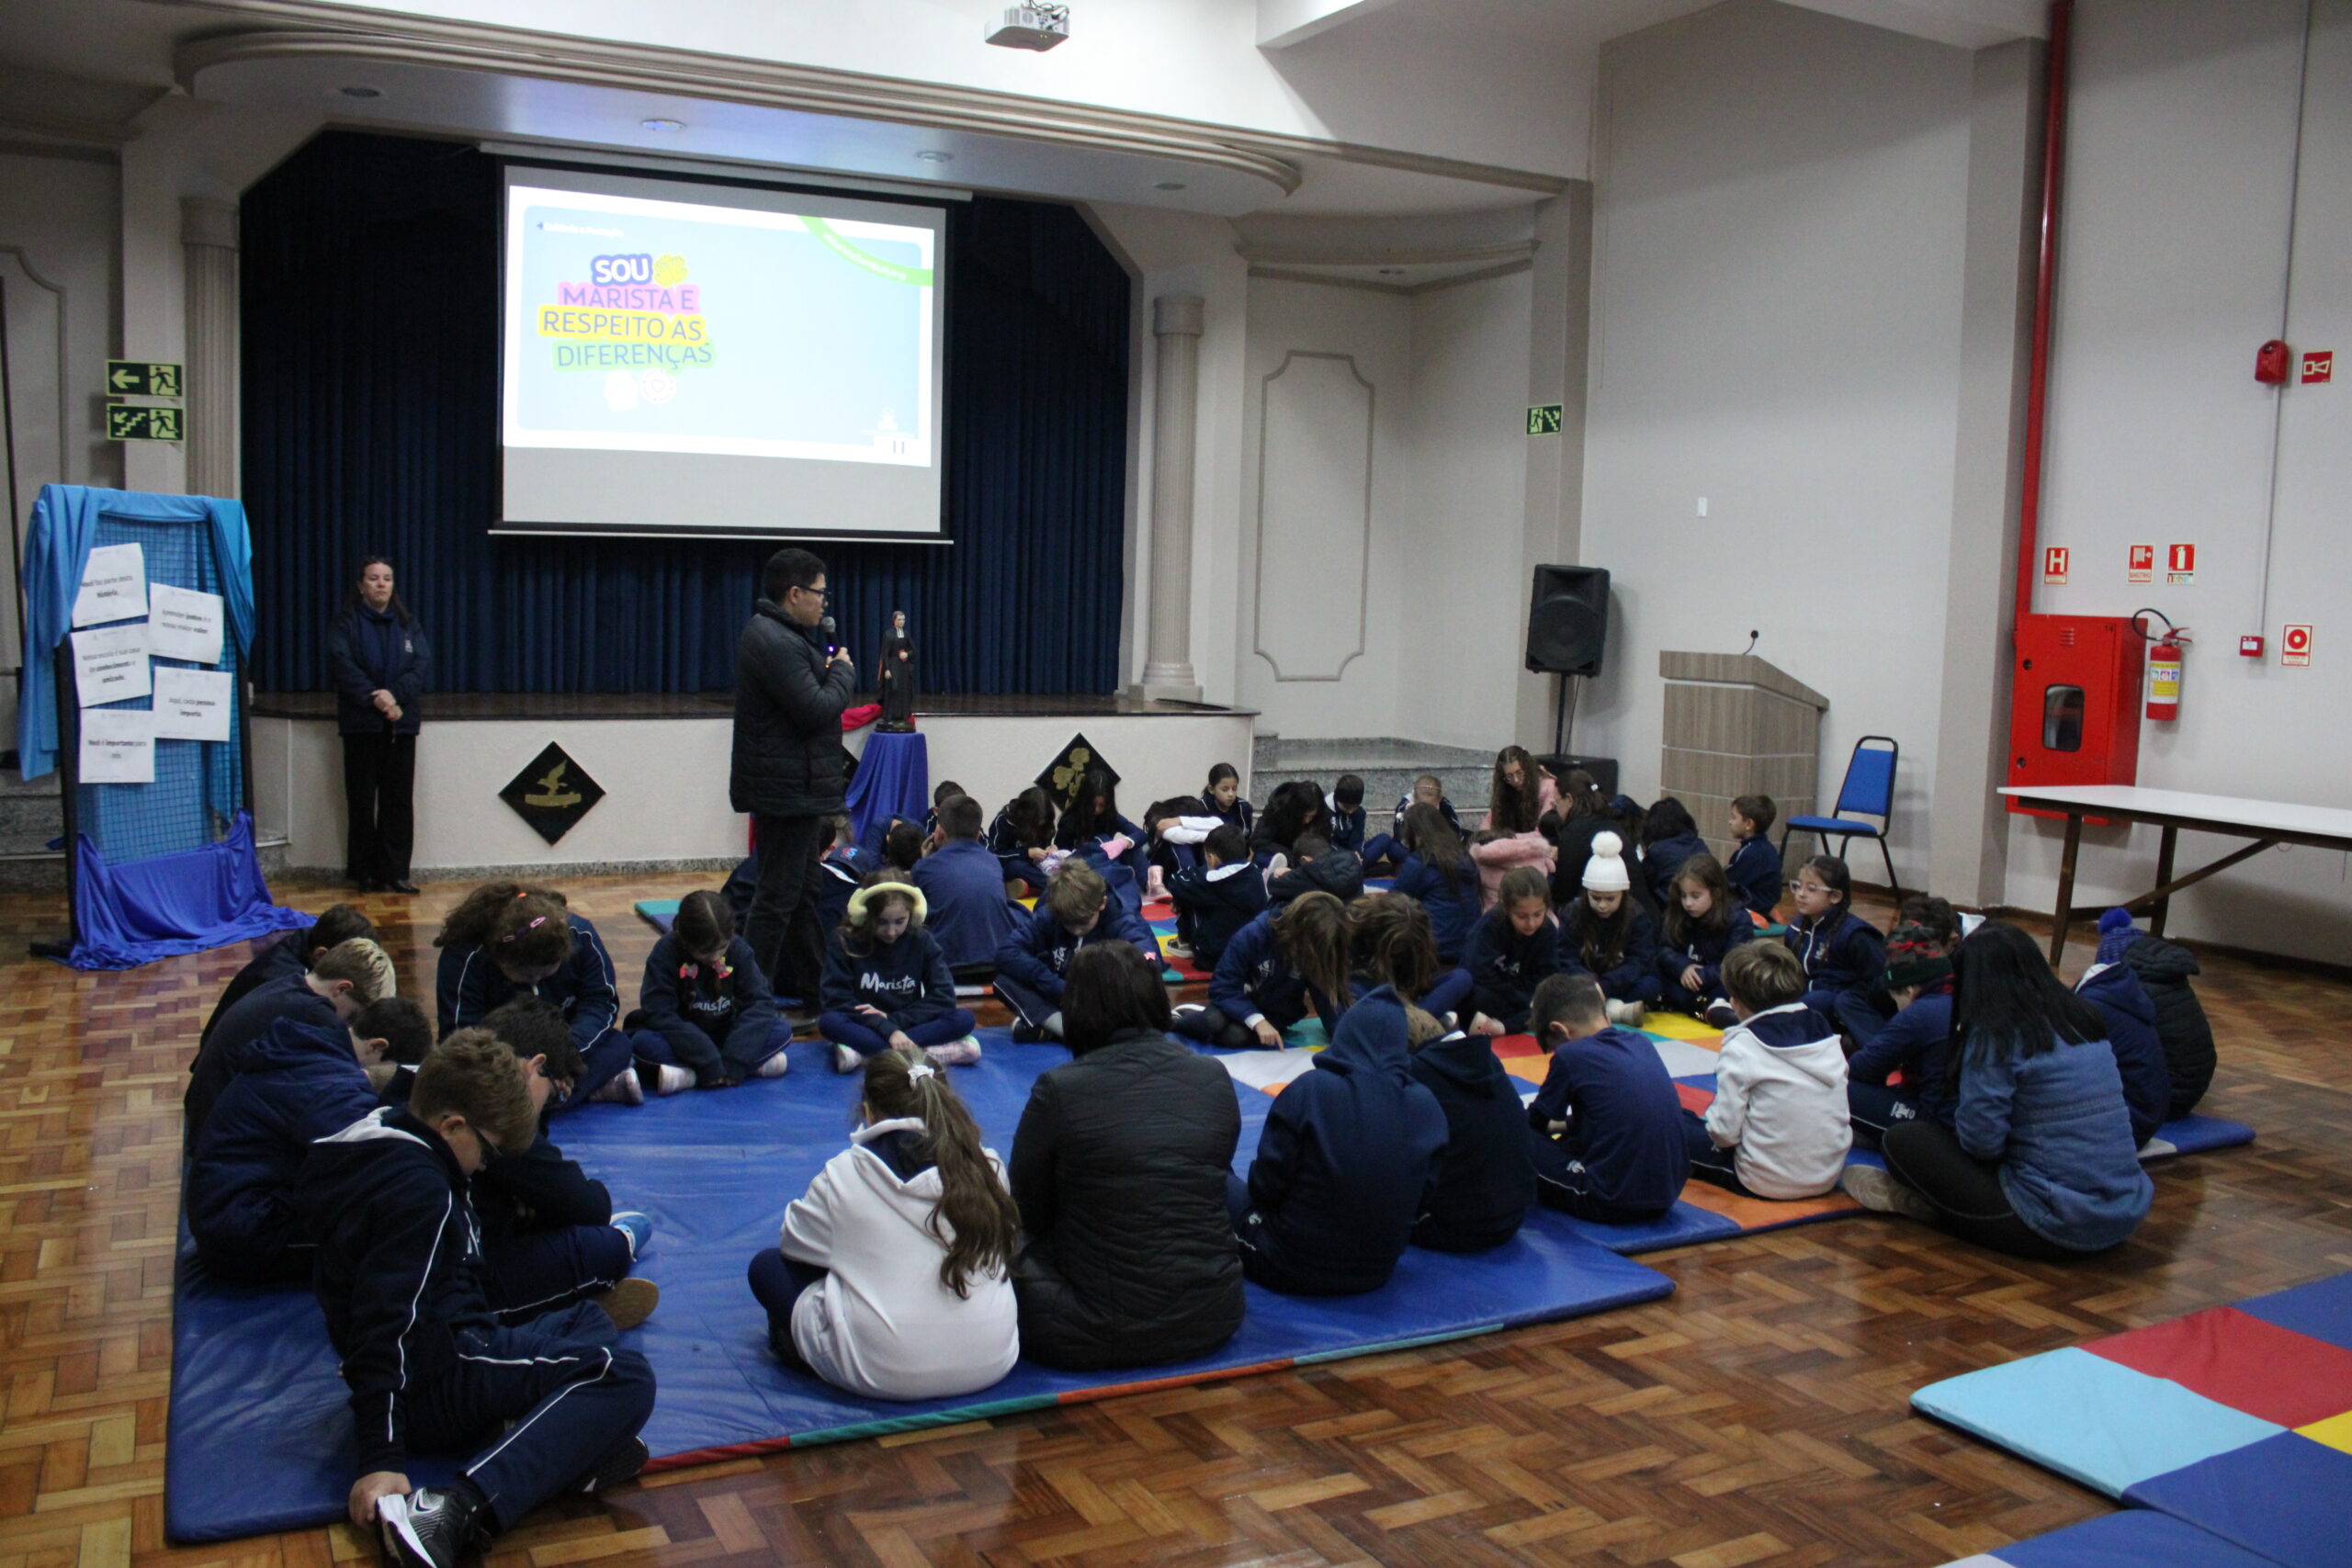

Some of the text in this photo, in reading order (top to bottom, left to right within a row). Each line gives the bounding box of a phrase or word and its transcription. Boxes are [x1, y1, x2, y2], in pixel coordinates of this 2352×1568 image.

[595, 258, 650, 283] SOU
[563, 287, 695, 310] MARISTA E
[544, 310, 702, 341] RESPEITO AS
[558, 343, 712, 369] DIFERENÇAS
[2049, 549, 2065, 572] H
[860, 972, 915, 993] Marista
[690, 991, 731, 1012] arista
